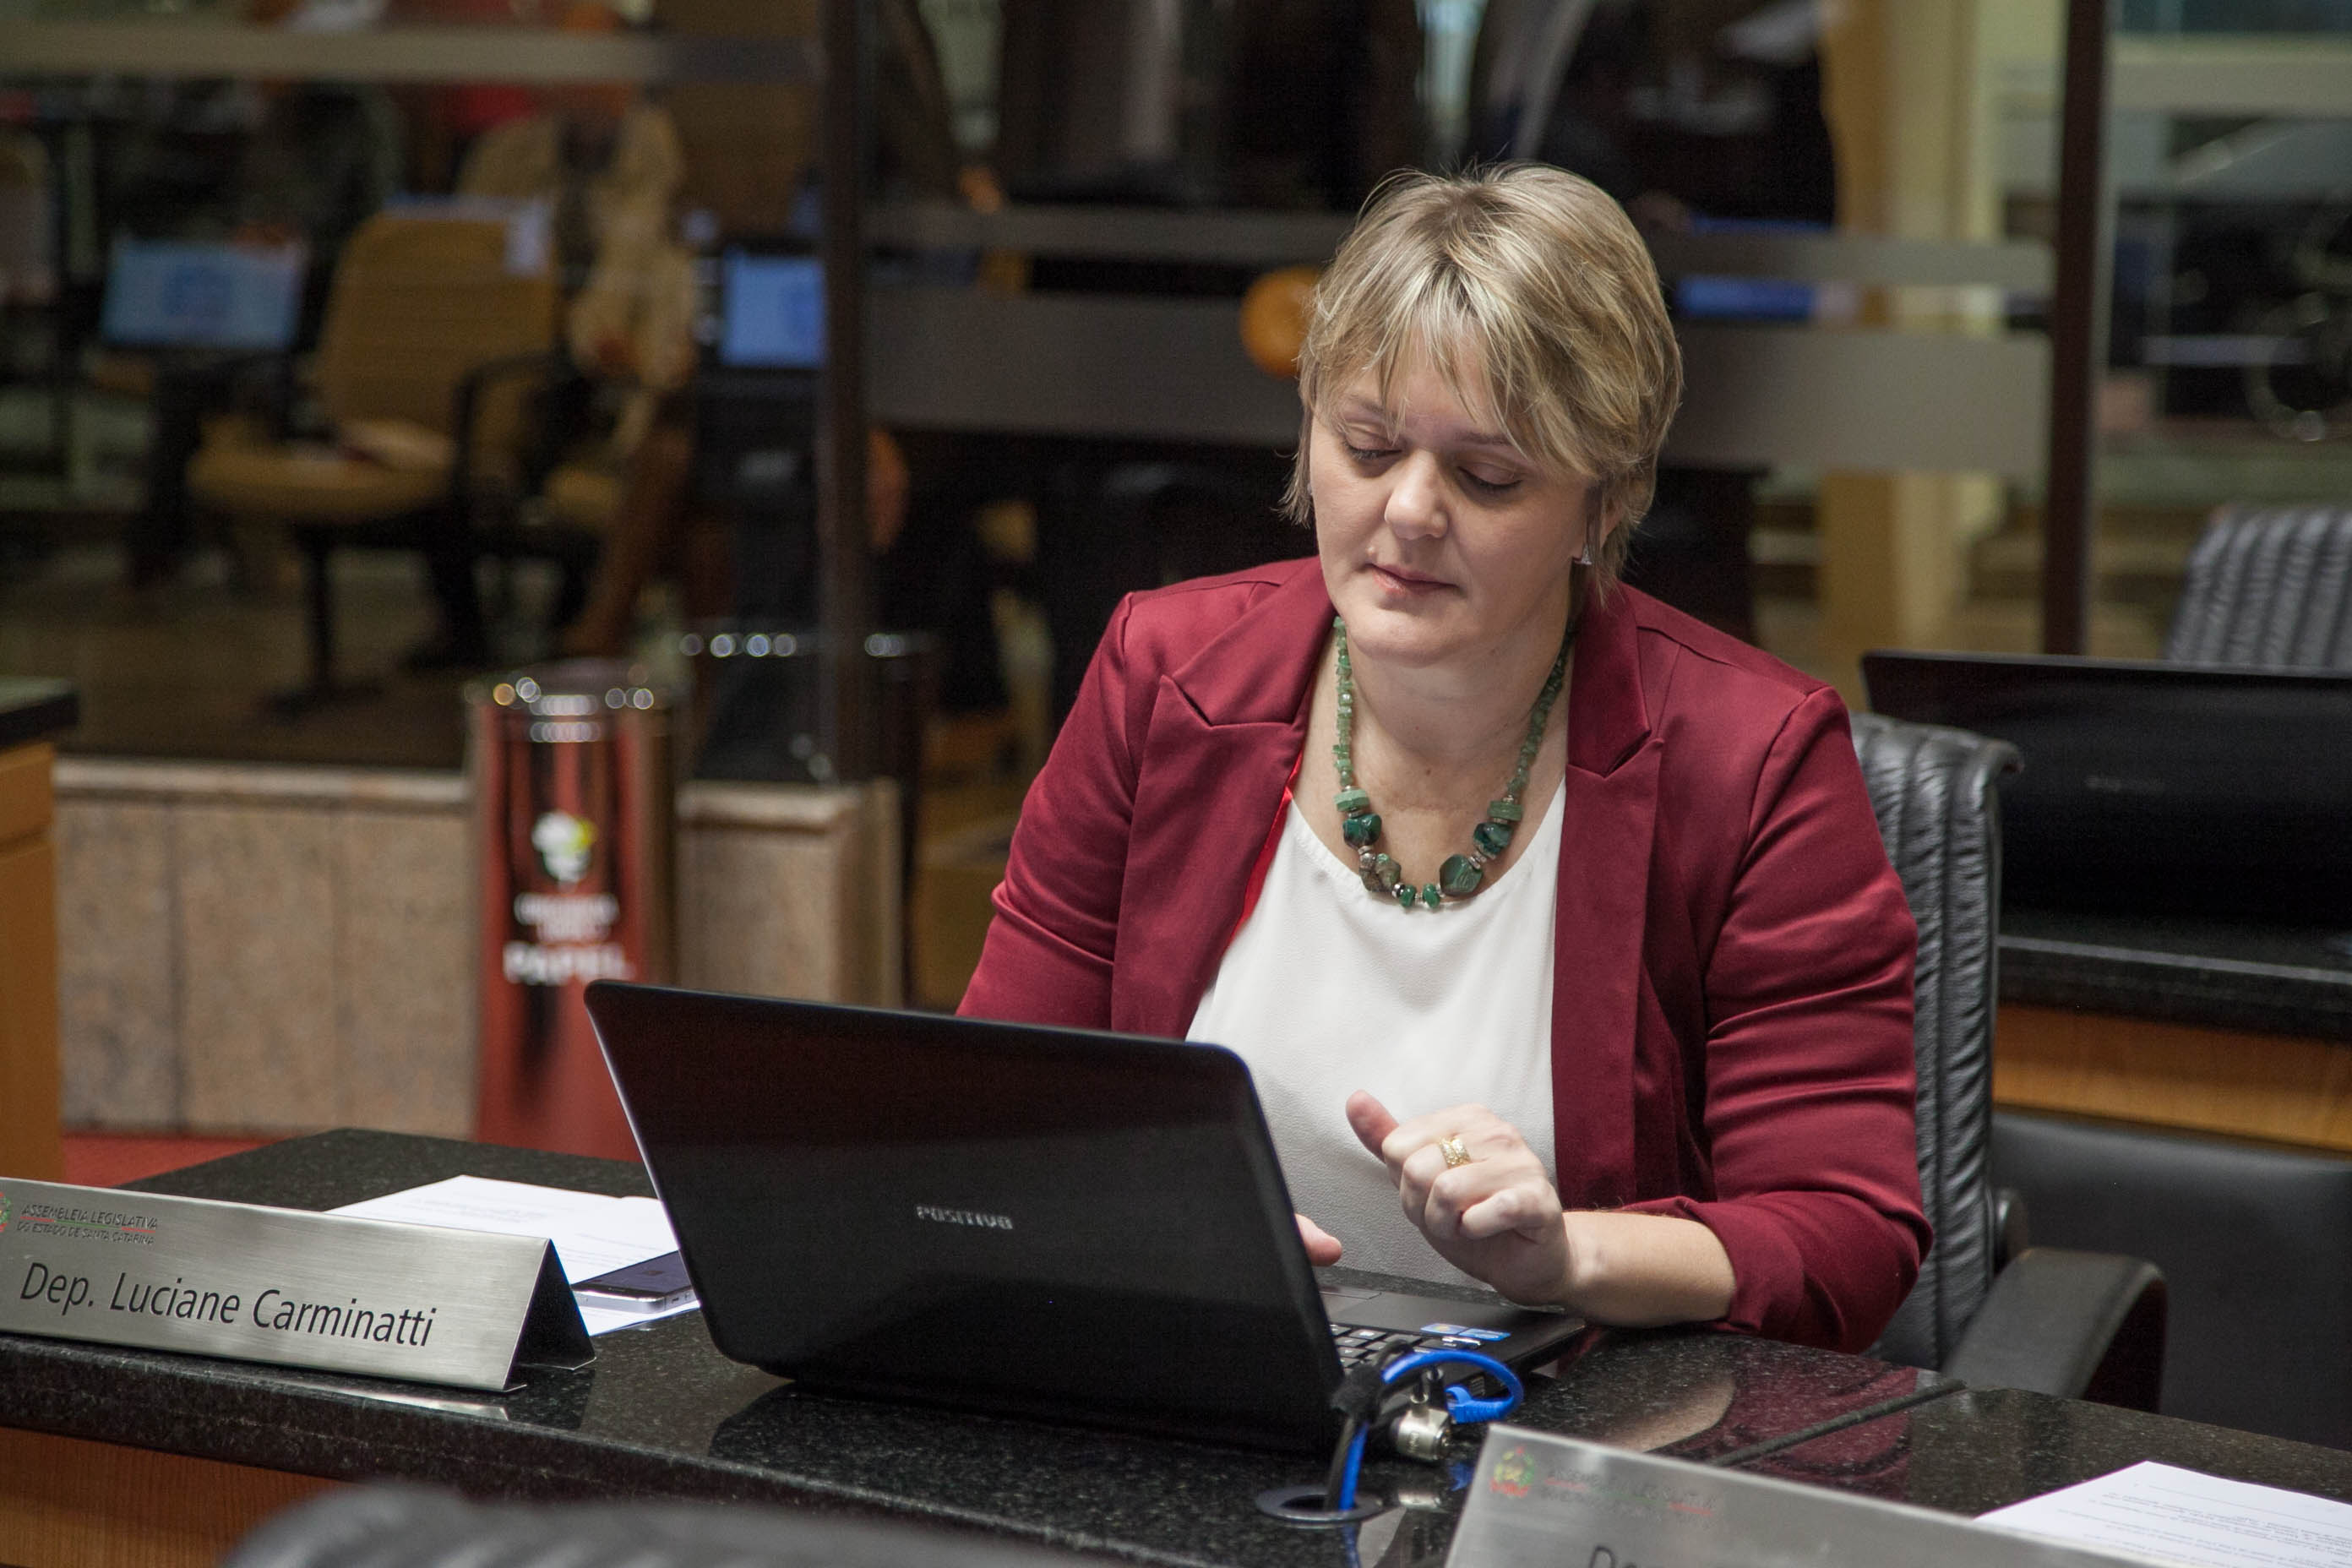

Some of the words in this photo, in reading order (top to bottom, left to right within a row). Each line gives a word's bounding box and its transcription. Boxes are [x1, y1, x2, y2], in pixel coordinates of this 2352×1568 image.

[22, 1204, 87, 1222] ASSEMBLEIA
[90, 1211, 158, 1229] LEGISLATIVA
[32, 1222, 65, 1236] ESTADO
[68, 1227, 80, 1238] DE
[20, 1262, 94, 1316] Dep.
[110, 1272, 240, 1324] Luciane
[253, 1289, 438, 1347] Carminatti
